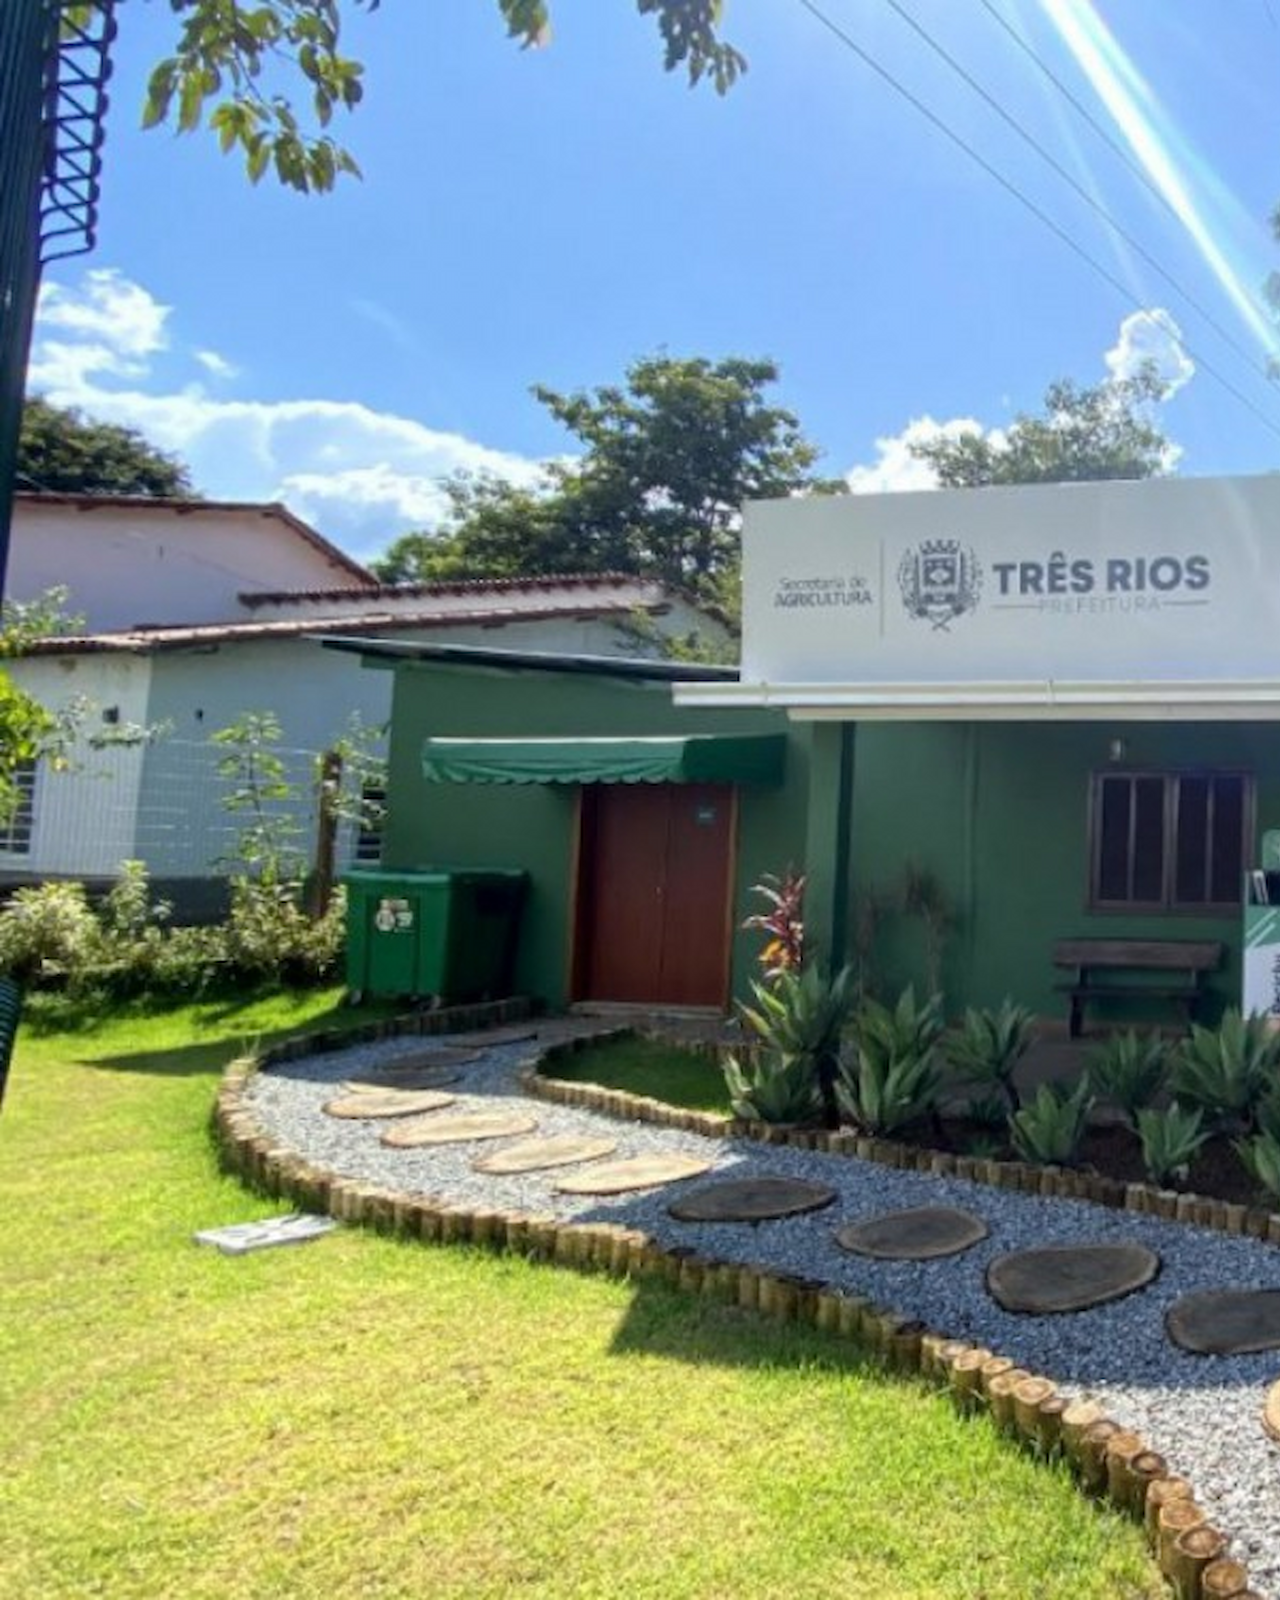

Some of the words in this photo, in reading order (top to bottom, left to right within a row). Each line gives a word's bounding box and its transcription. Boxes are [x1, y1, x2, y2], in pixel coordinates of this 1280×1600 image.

[993, 552, 1095, 597] TRÊS
[1107, 555, 1211, 592] RIOS
[779, 577, 845, 592] Secretaria
[774, 590, 874, 609] AGRICULTURA
[1039, 597, 1161, 615] PREFEITURA
